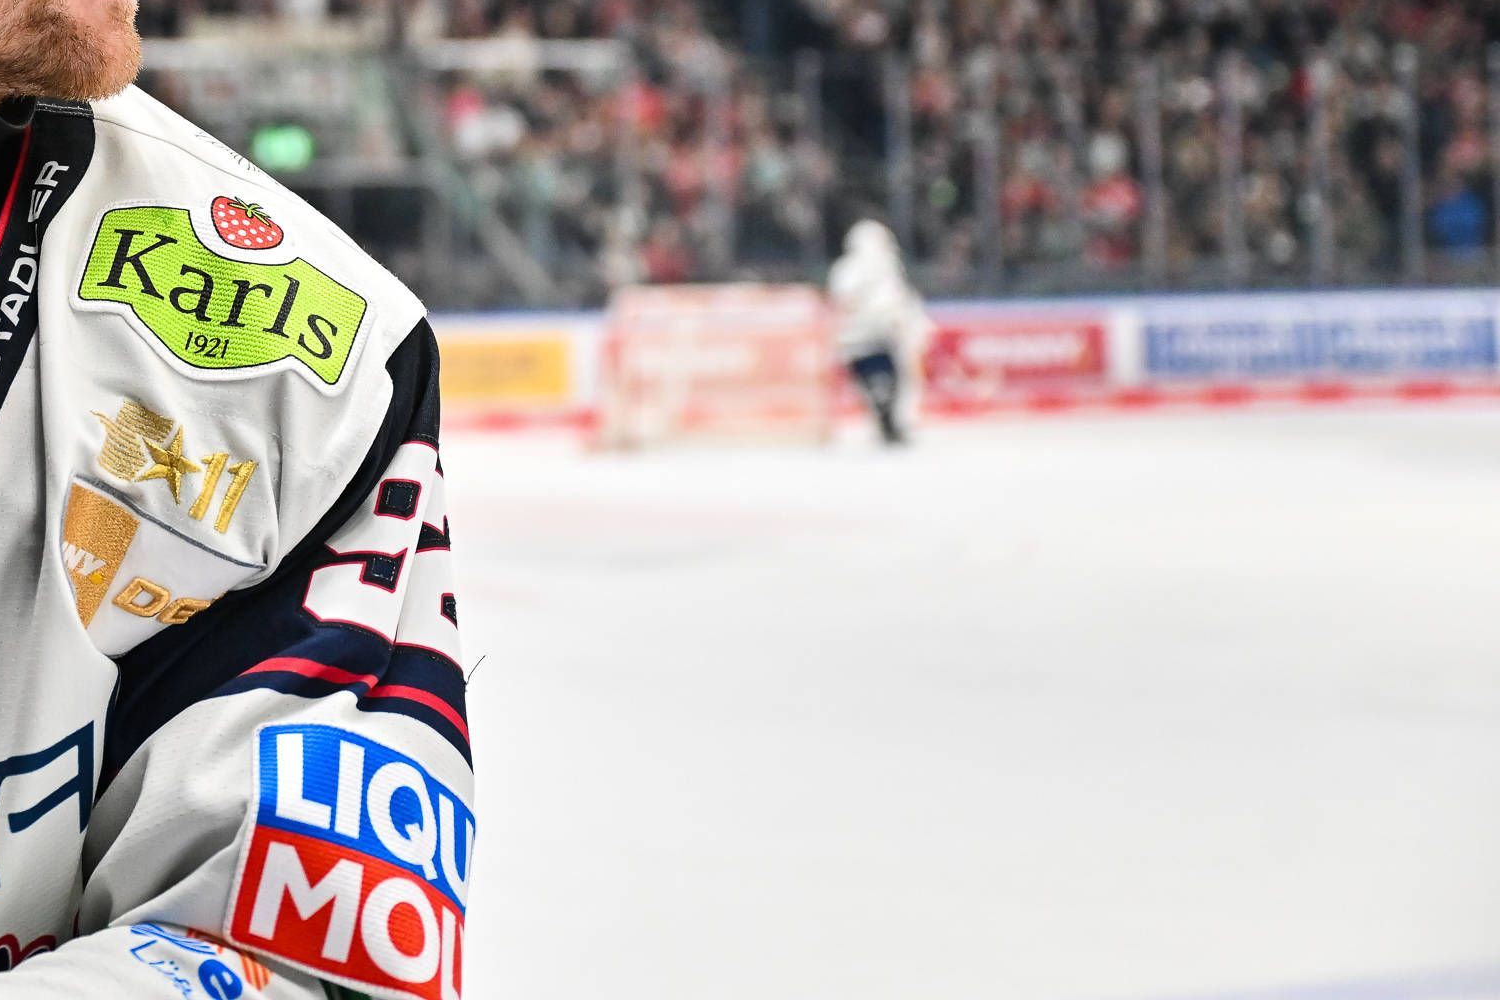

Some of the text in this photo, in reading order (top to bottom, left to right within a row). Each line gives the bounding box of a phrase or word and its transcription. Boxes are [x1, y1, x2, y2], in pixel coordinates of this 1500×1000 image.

[97, 228, 338, 361] Karls
[184, 331, 230, 359] 1921
[61, 541, 107, 577] NY
[112, 575, 228, 625] DE
[248, 841, 463, 1000] MOL
